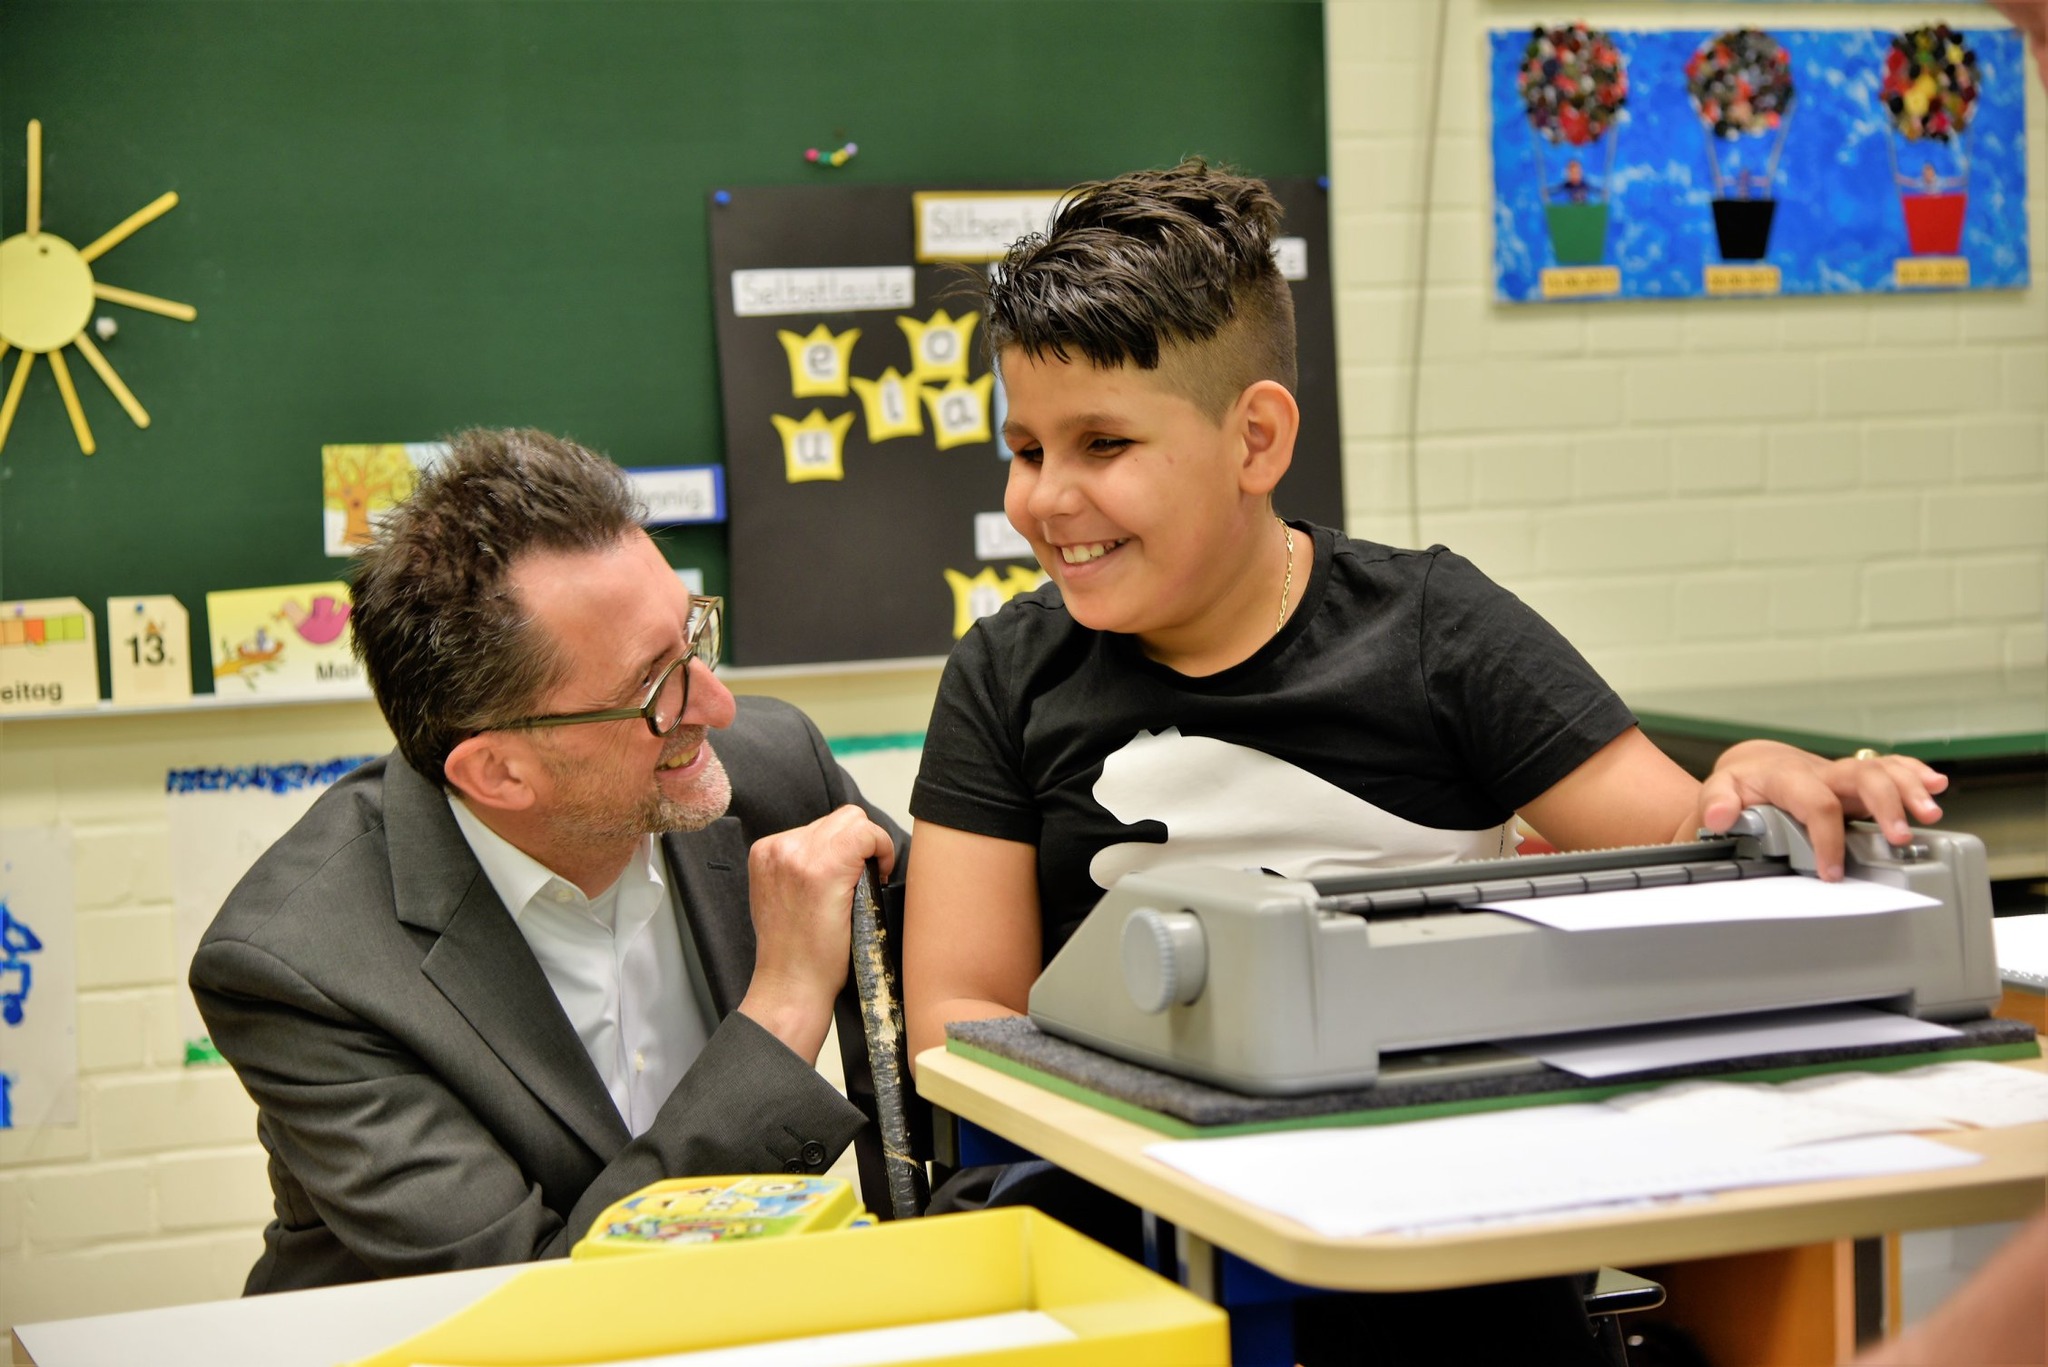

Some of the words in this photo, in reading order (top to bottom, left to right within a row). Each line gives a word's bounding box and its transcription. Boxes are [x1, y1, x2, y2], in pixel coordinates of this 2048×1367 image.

[741, 270, 906, 307] Selbstlaute
[807, 343, 834, 376] e
[926, 328, 957, 362] o
[942, 396, 977, 430] a
[796, 432, 830, 463] u
[125, 633, 176, 667] 13.
